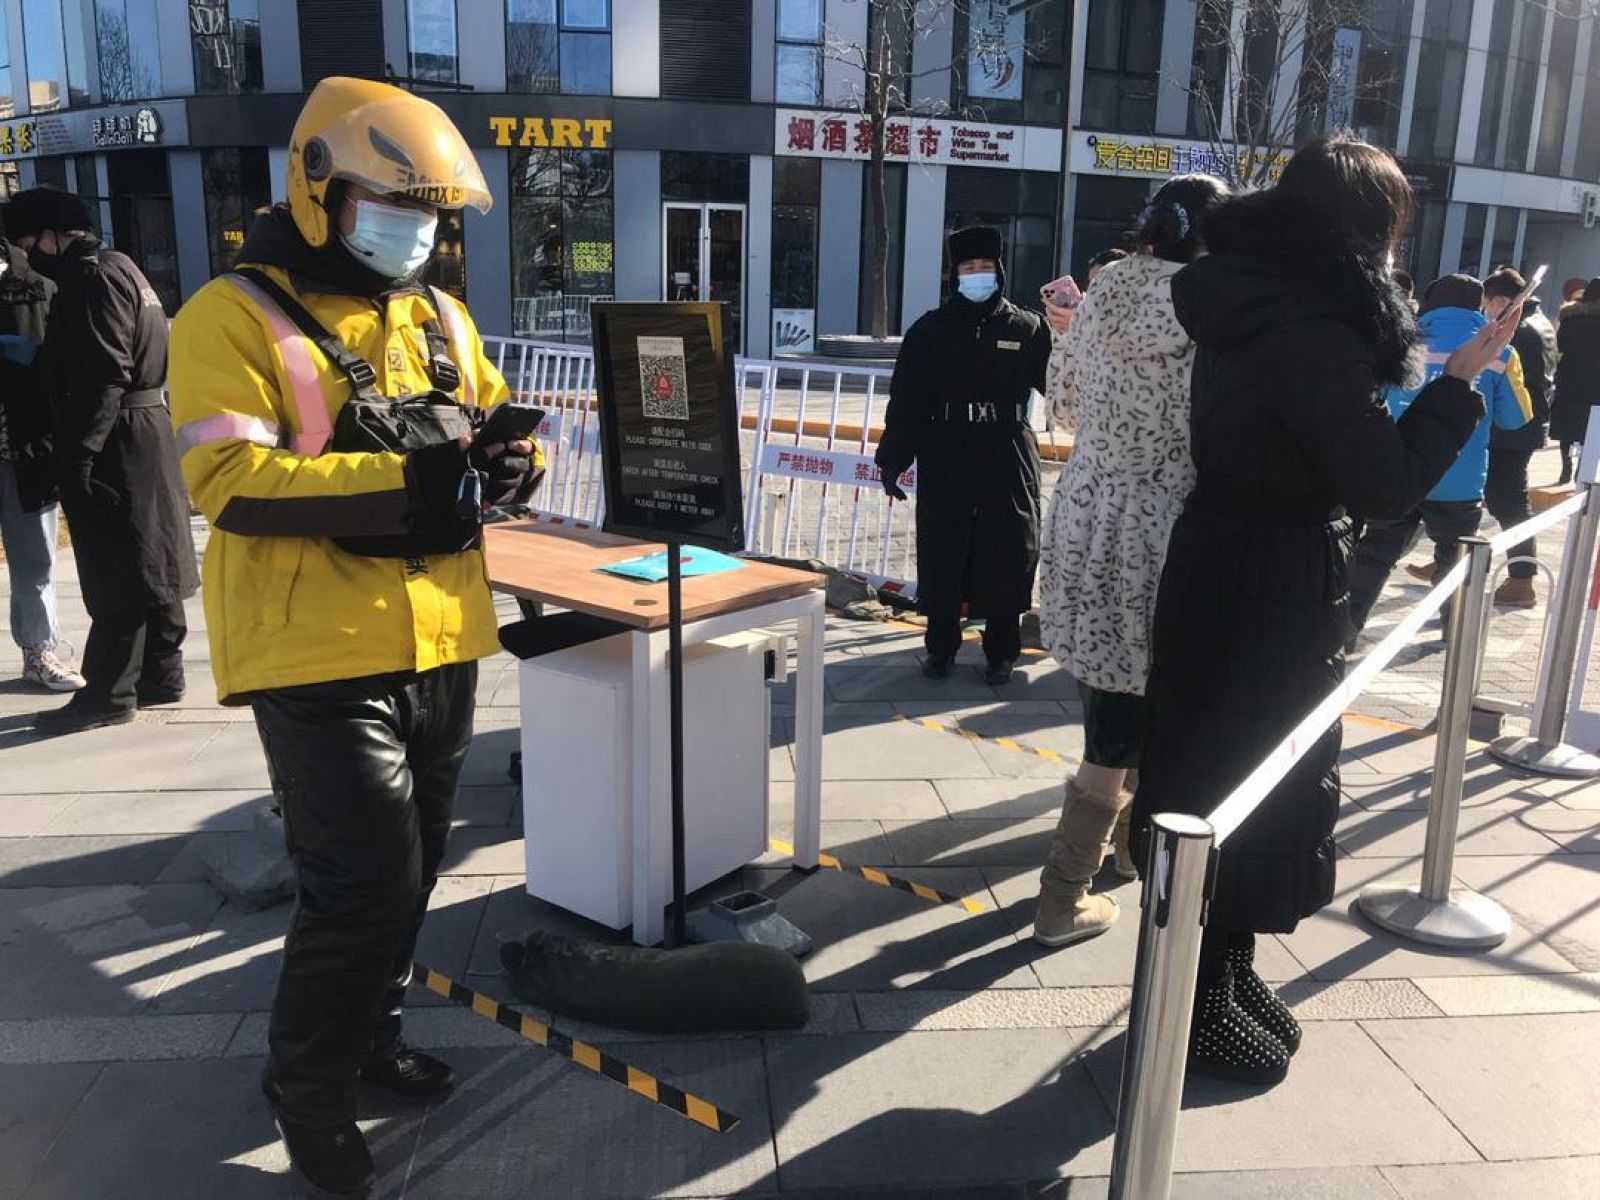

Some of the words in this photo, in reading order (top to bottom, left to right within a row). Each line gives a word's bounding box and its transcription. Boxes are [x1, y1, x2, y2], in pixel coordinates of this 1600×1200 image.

[489, 116, 612, 148] TART
[787, 117, 942, 158] 烟酒茶超市
[951, 126, 990, 138] Tobacco
[996, 130, 1014, 140] and
[951, 138, 975, 148] Wine
[981, 139, 999, 150] Tea
[950, 148, 1010, 162] Supermarket
[777, 452, 834, 475] 严禁抛物
